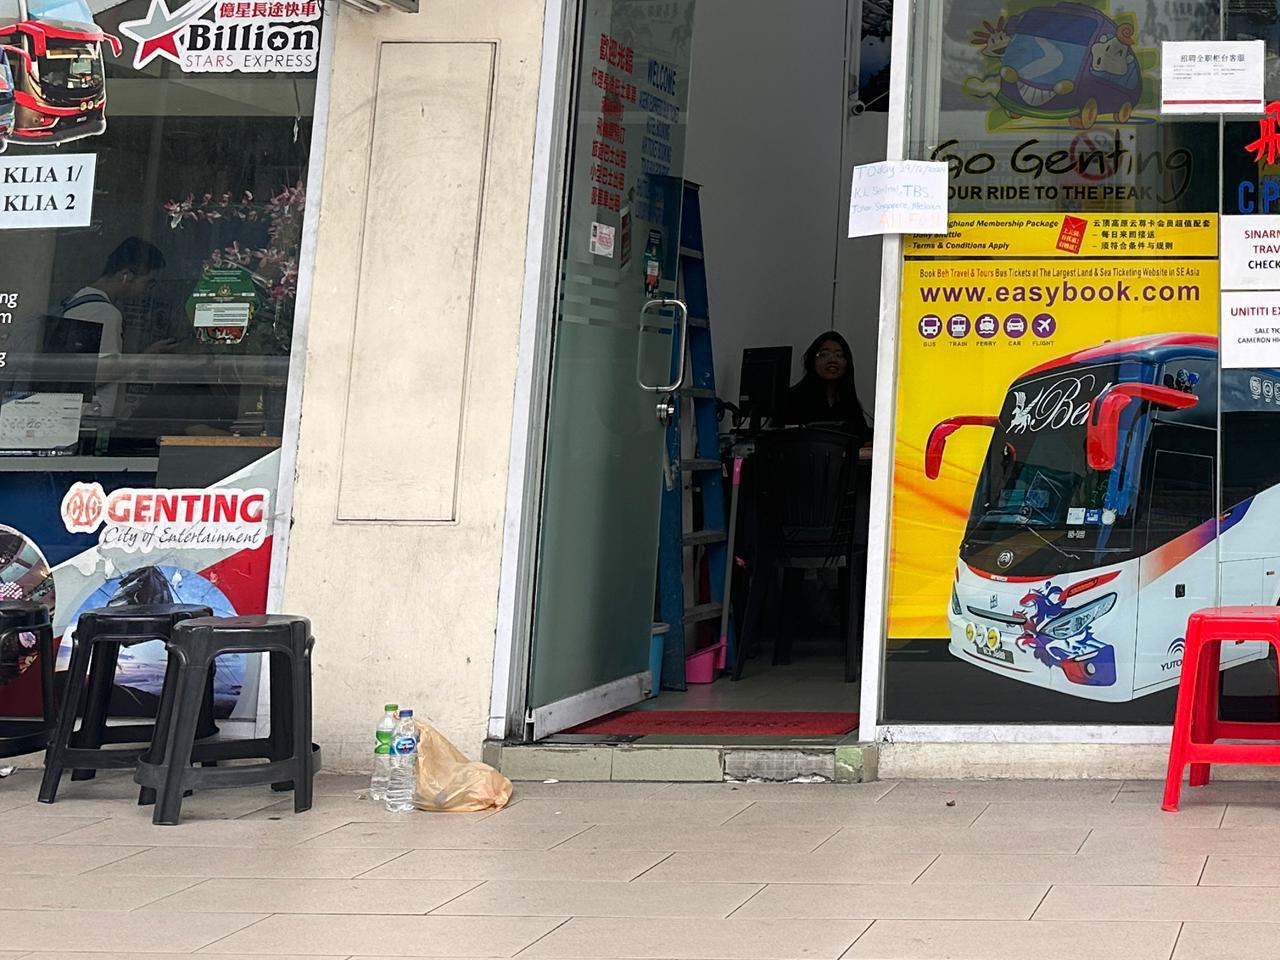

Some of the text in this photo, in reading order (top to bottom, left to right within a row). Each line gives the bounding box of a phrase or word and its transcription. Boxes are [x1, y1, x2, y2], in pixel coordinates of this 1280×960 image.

[220, 1, 317, 18] 億星長途快車
[186, 24, 314, 52] Billion
[186, 54, 313, 67] STARS EXPRESS
[1010, 129, 1193, 204] Genting
[3, 167, 58, 184] KLIA
[948, 185, 1151, 200] OUR RIDE TO THE PEAK
[1239, 181, 1254, 215] C
[1263, 181, 1279, 215] P
[3, 194, 76, 212] KLIA 2
[976, 220, 1024, 228] Membership
[1026, 220, 1058, 228] Package
[988, 242, 1009, 250] Apply
[920, 269, 935, 277] Book
[937, 269, 949, 277] Beh
[951, 269, 969, 277] Travel
[977, 268, 994, 277] Tours
[996, 268, 1007, 277] Bus
[1009, 268, 1031, 277] Tickets
[1040, 268, 1051, 277] The
[1052, 268, 1076, 278] Largest
[1077, 268, 1092, 277] Land
[1100, 268, 1111, 277] Sea
[1113, 268, 1141, 278] Ticketing
[1143, 268, 1168, 276] Website
[1176, 268, 1184, 276] SE
[1186, 268, 1200, 276] Asia
[920, 281, 1200, 307] www.easybook.com
[1230, 307, 1269, 316] UNITITI
[108, 494, 264, 523] GENTING
[103, 524, 261, 548] City of Entertainment
